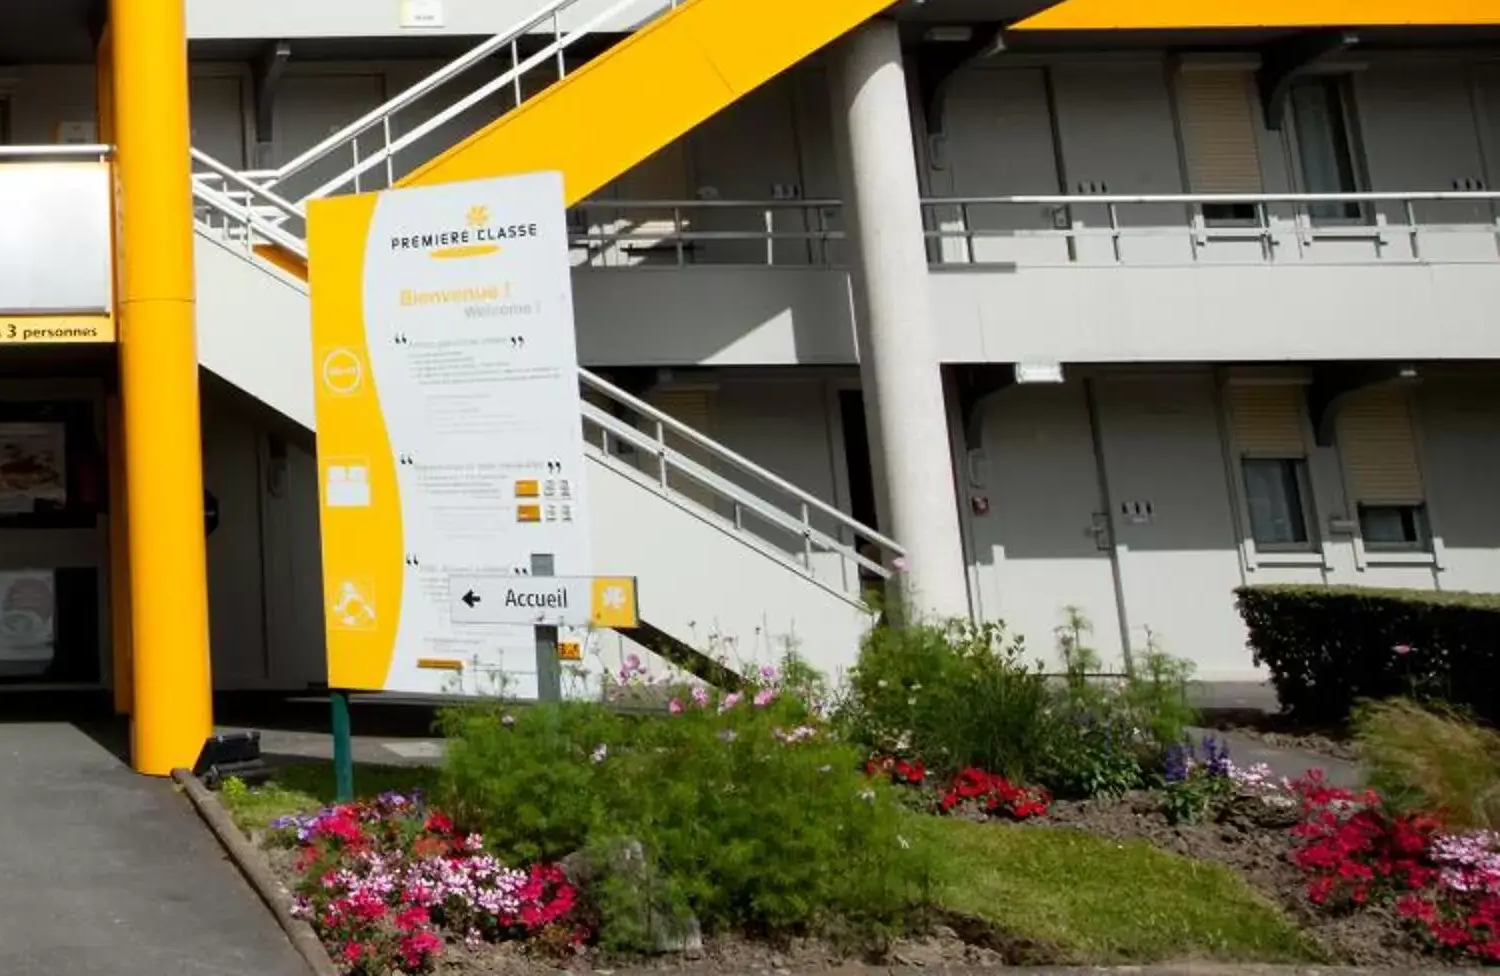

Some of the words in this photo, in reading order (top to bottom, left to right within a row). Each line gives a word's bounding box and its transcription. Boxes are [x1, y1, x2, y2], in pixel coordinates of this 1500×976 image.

[391, 230, 469, 249] PREMIERE
[477, 223, 537, 240] CLASSE
[7, 323, 17, 338] 3
[505, 588, 568, 608] Accueil
